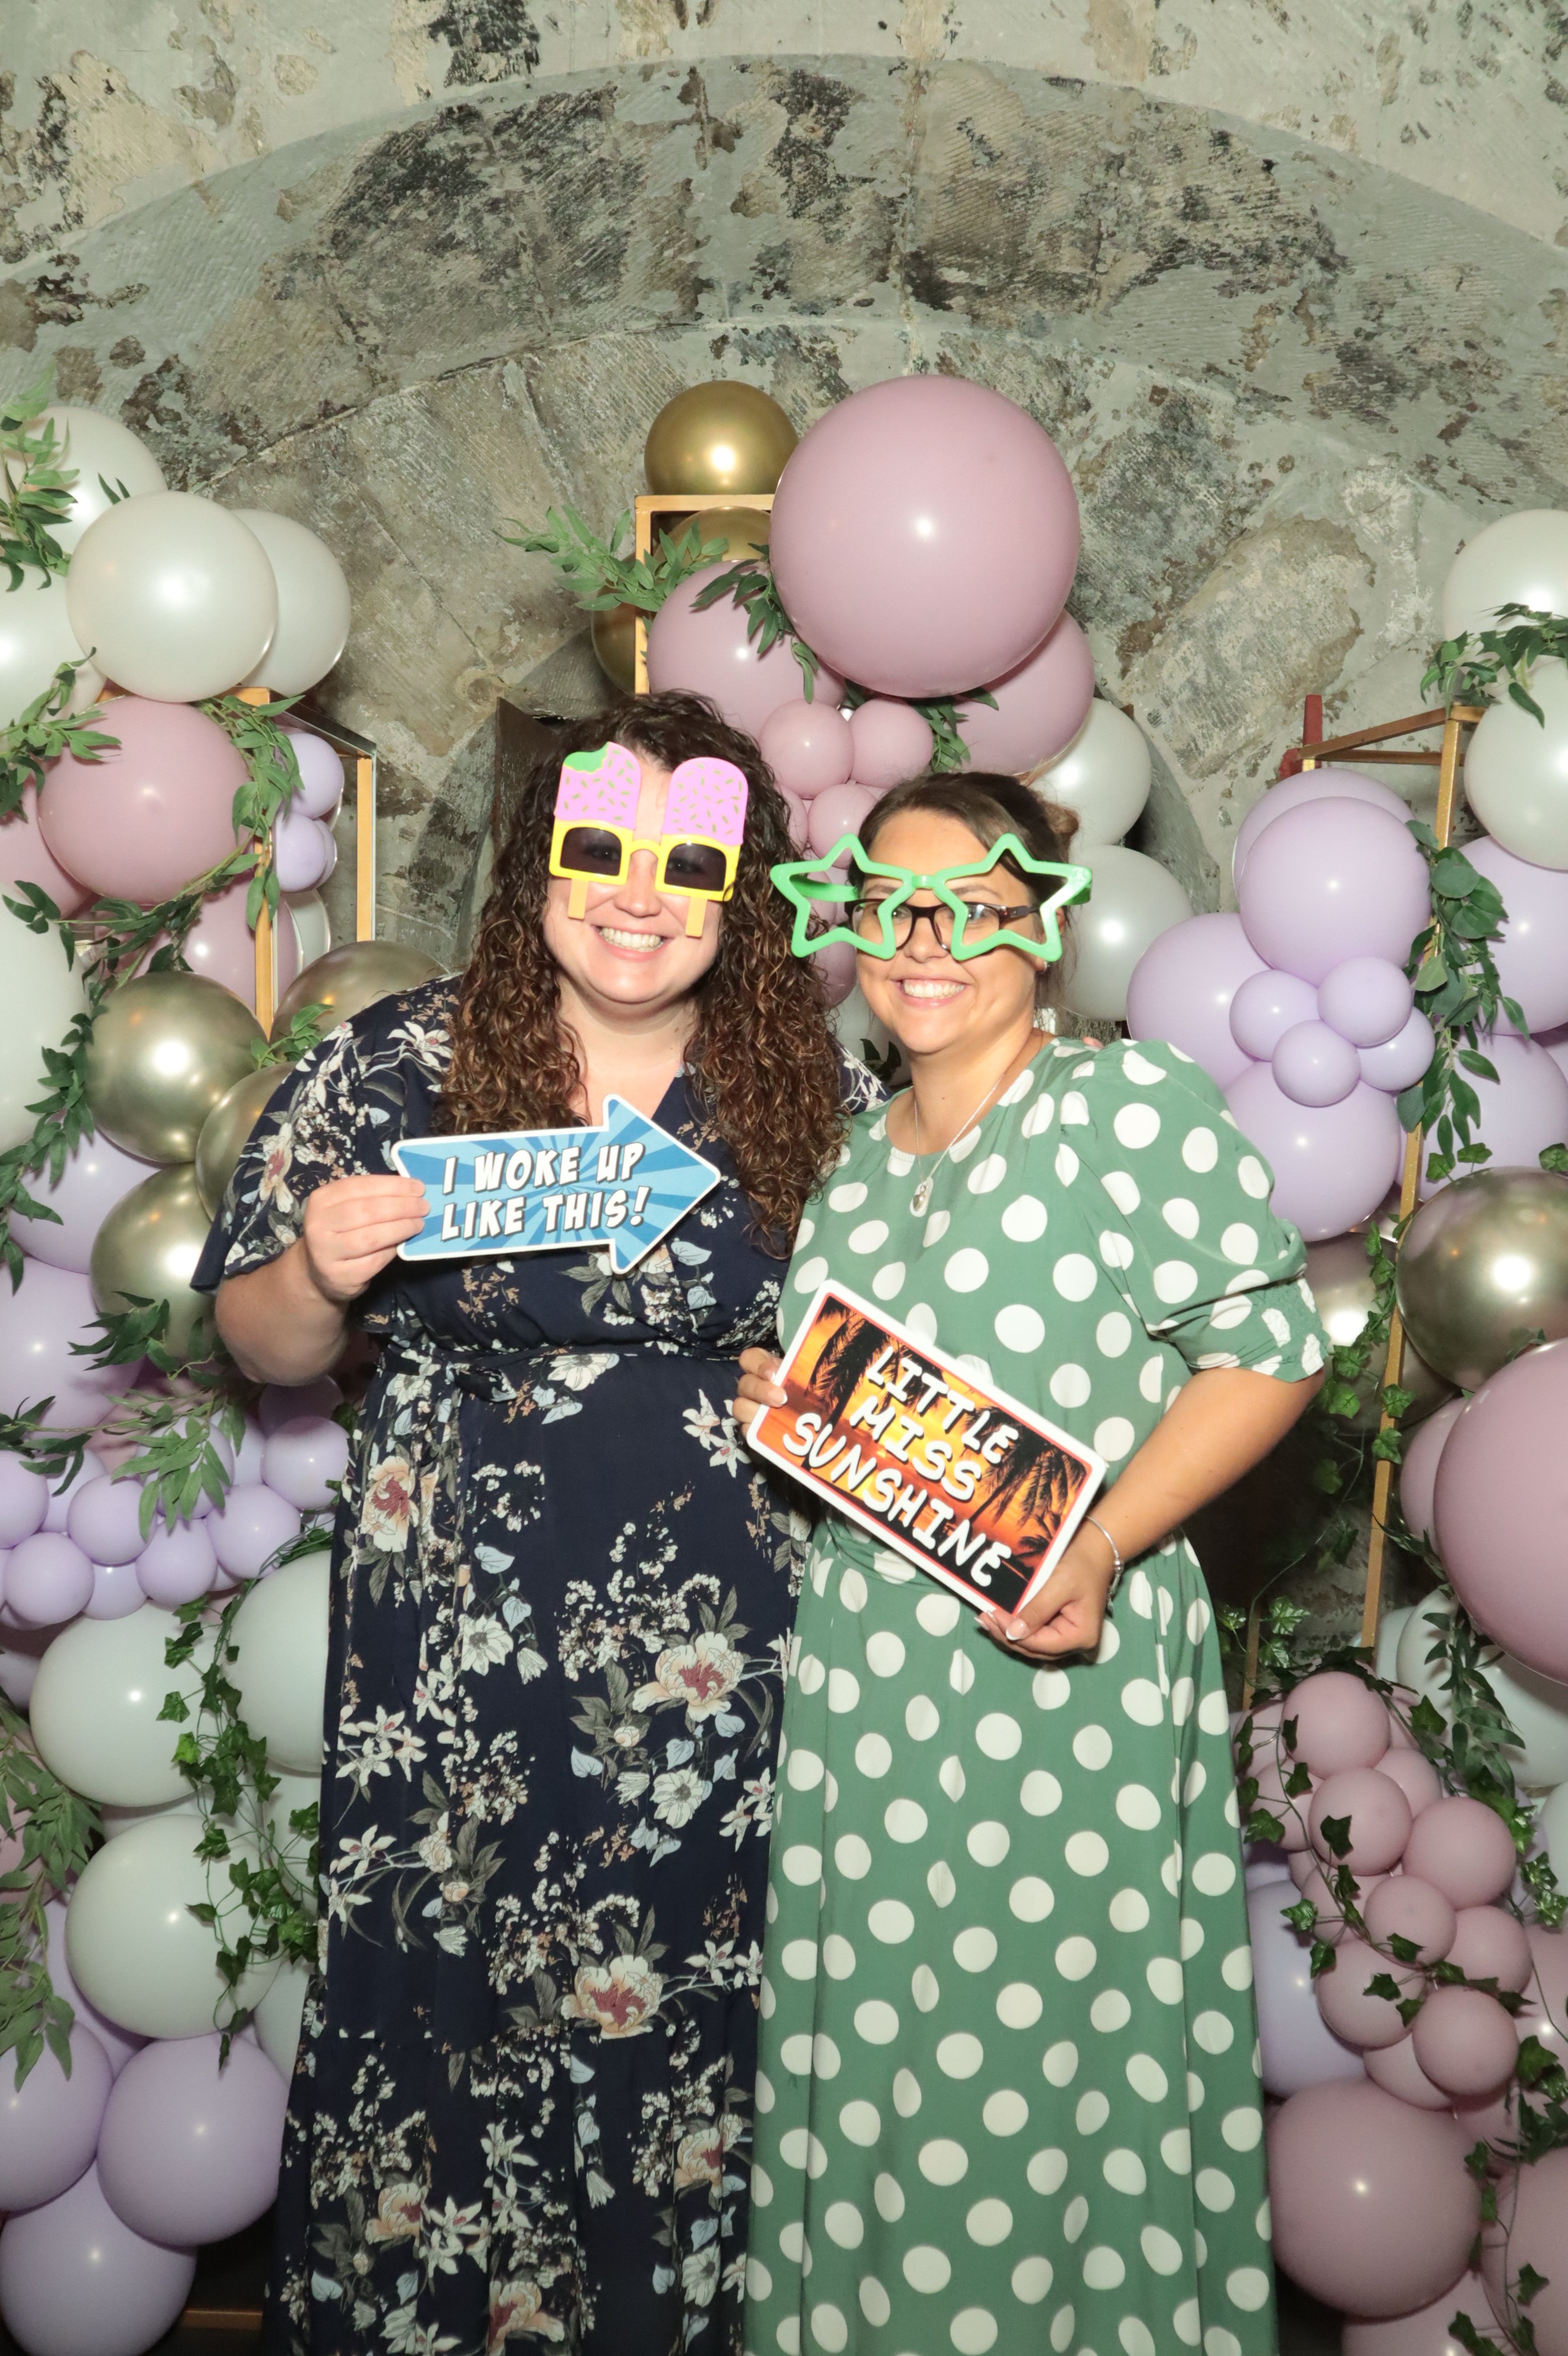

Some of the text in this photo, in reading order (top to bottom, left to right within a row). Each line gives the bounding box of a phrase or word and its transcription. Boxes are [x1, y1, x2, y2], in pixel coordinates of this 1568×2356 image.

[440, 1185, 652, 1241] LIKE THIS!
[442, 1141, 646, 1195] I WOKE UP
[848, 1395, 982, 1500] MISS
[865, 1345, 1019, 1464] LITTLE
[782, 1412, 1012, 1588] SUNSHINE
